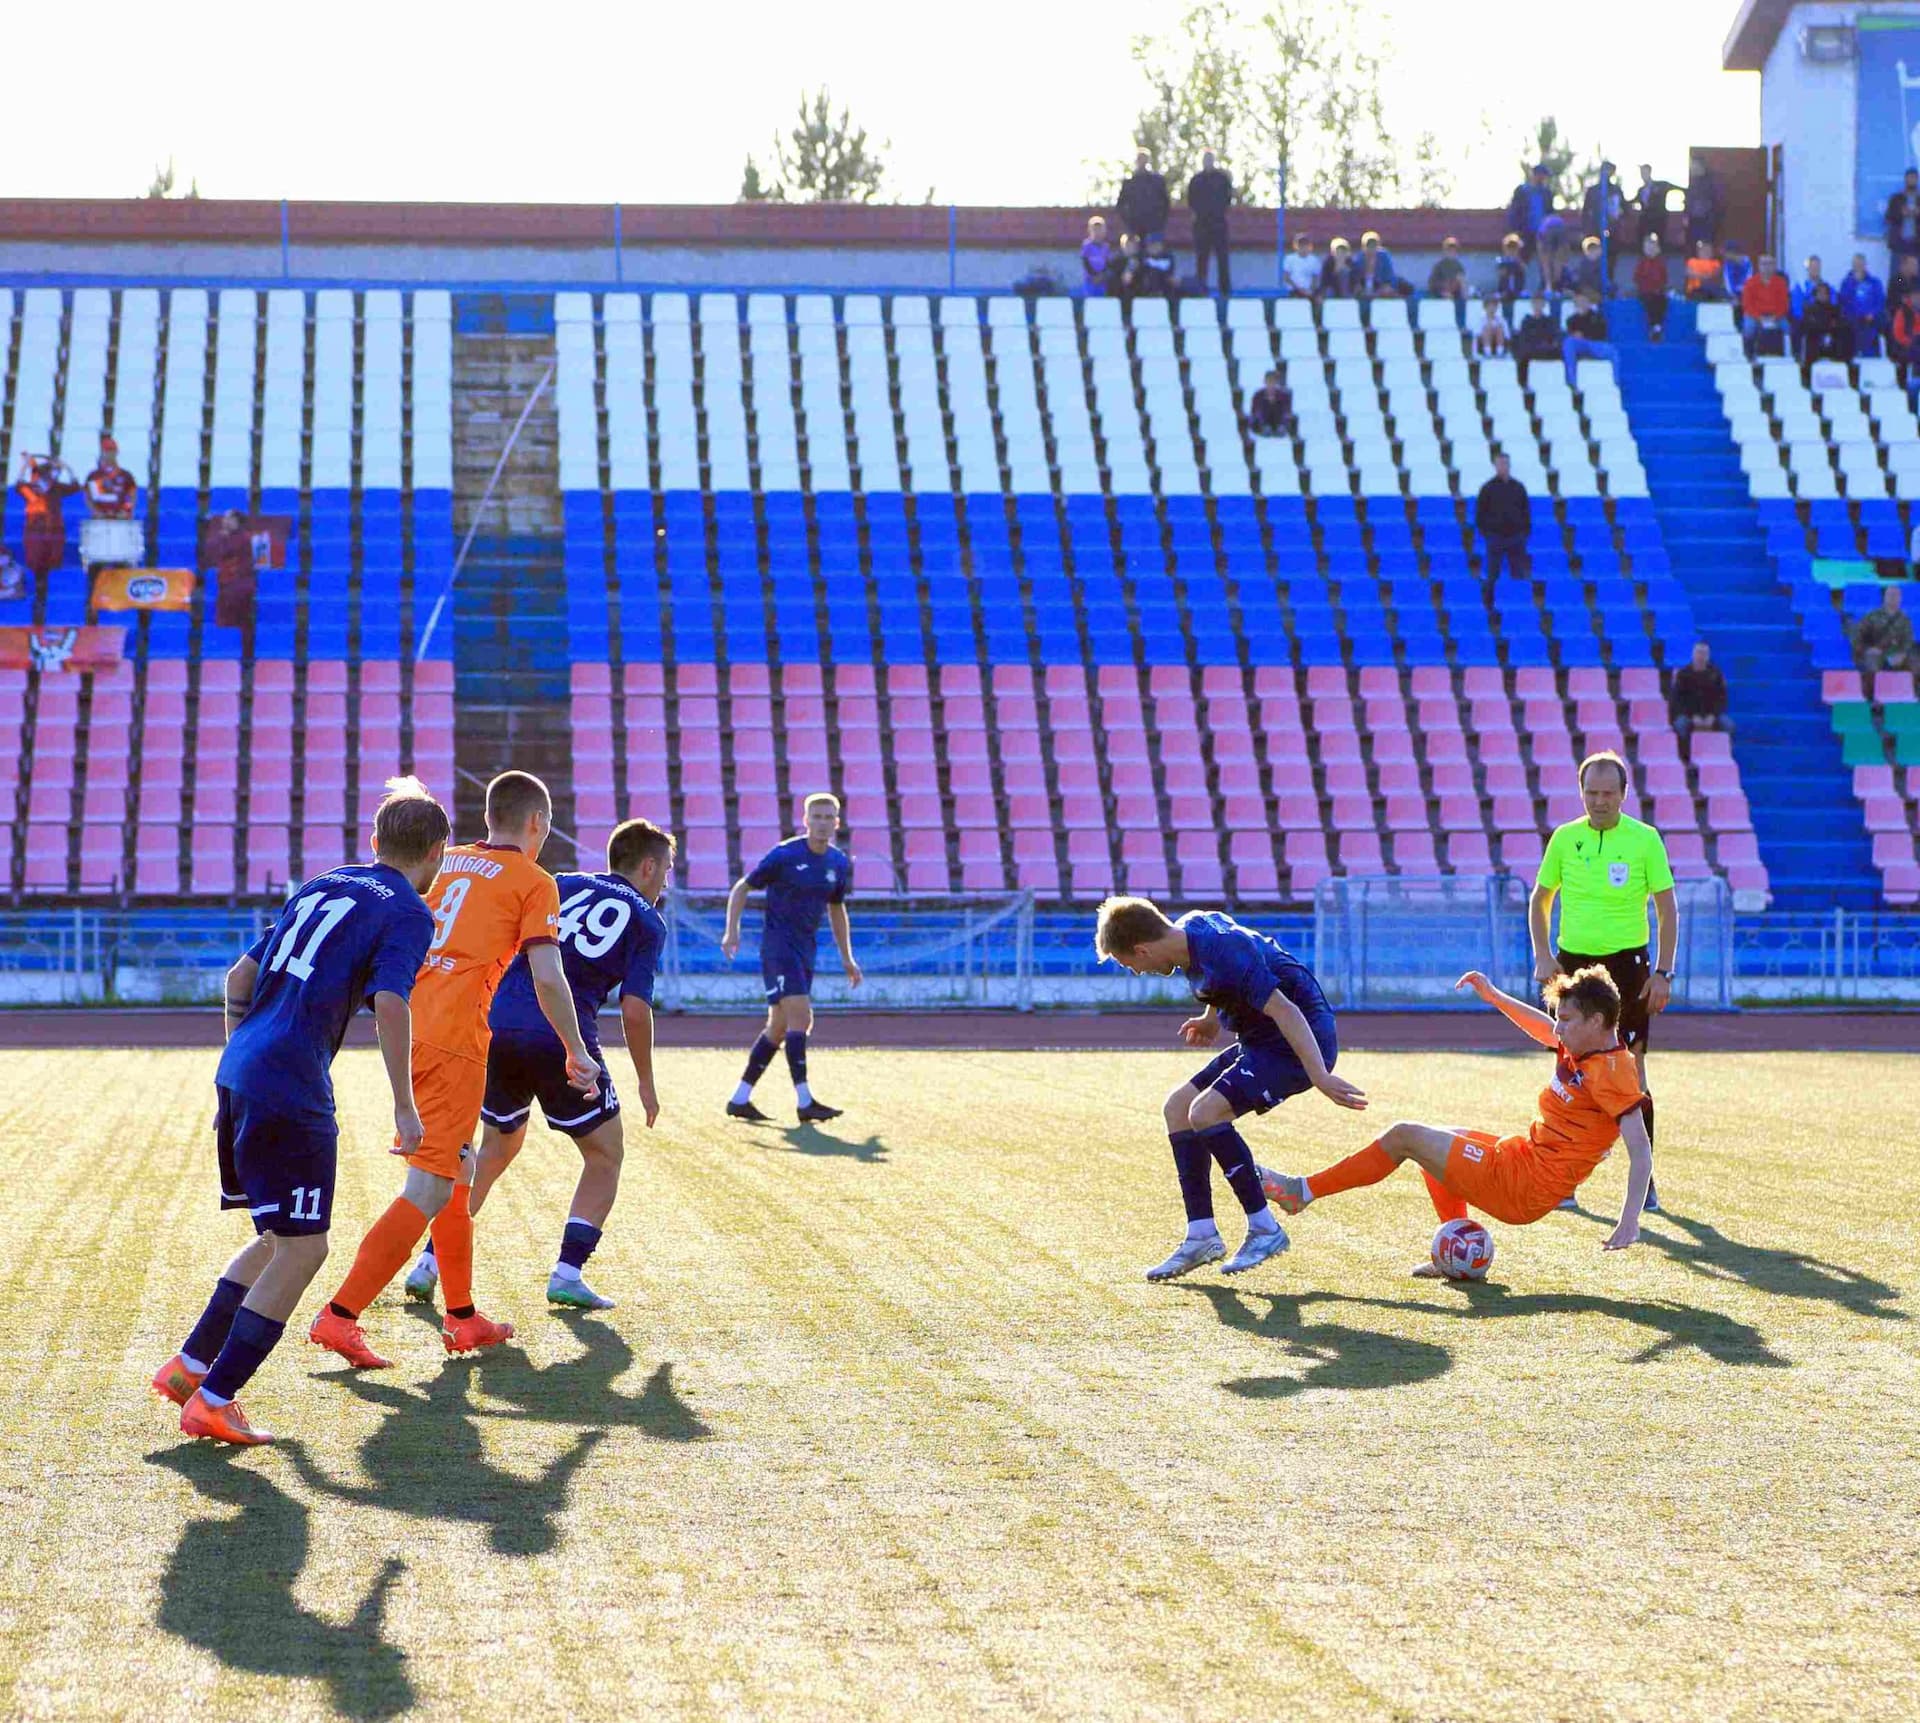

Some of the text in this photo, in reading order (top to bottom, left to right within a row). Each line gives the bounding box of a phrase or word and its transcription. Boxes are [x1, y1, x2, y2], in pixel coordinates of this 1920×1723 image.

[269, 891, 357, 982] 11
[430, 877, 472, 949] 9
[557, 888, 631, 959] 49
[289, 1186, 321, 1220] 11
